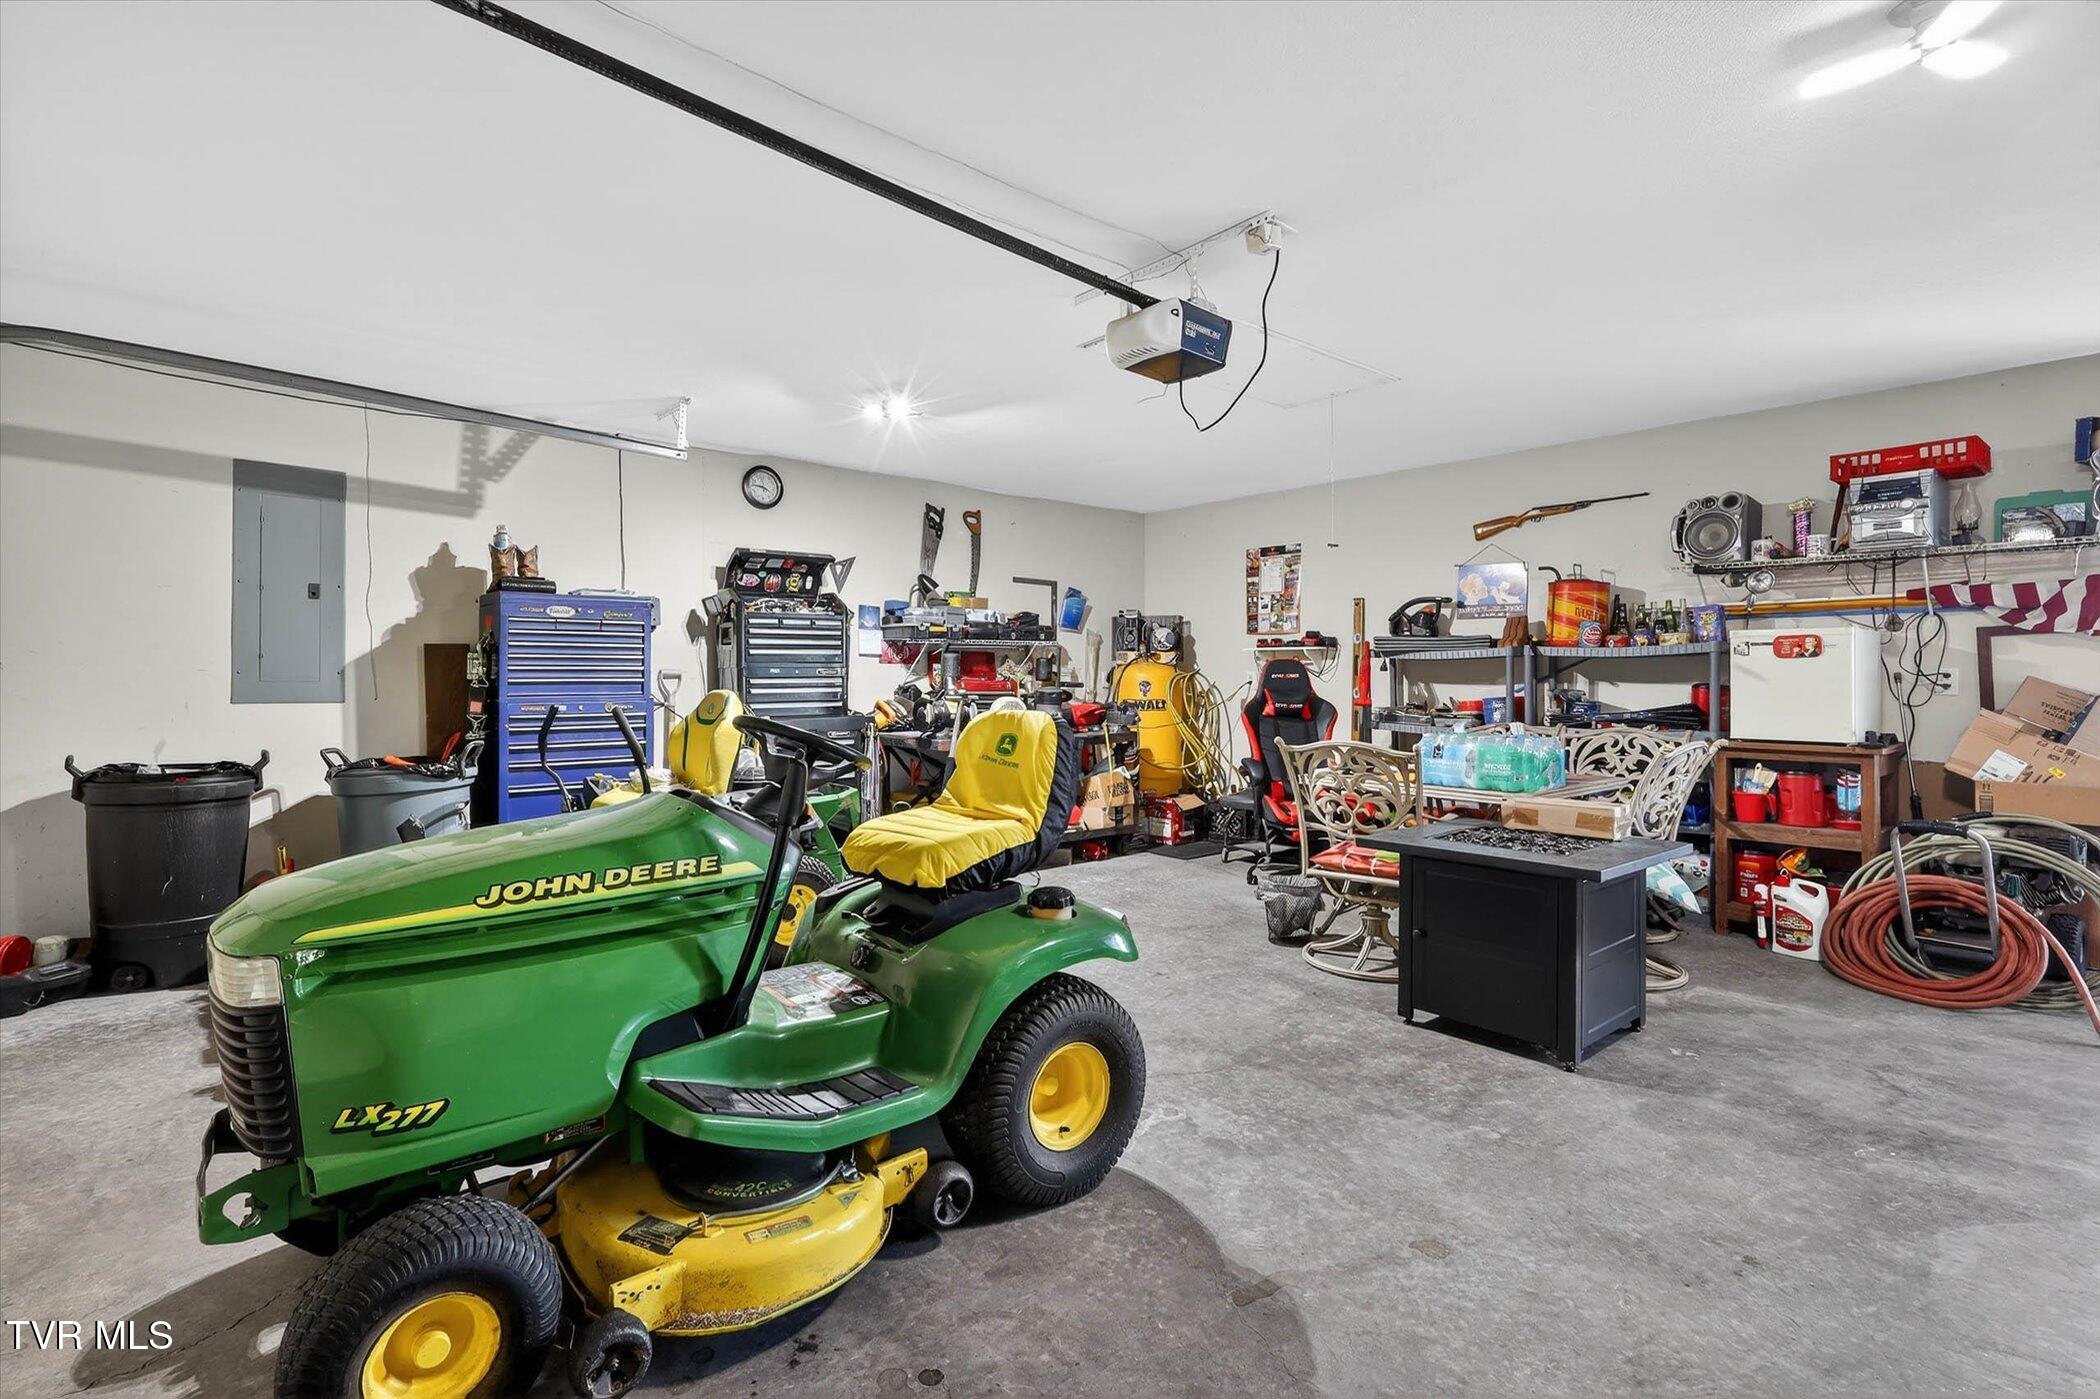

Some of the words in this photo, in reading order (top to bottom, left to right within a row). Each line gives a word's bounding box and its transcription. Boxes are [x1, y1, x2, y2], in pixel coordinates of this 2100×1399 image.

[1122, 699, 1166, 711] WALT
[474, 872, 595, 908] JOHN
[602, 855, 722, 891] DEERE
[330, 1099, 450, 1137] LX277
